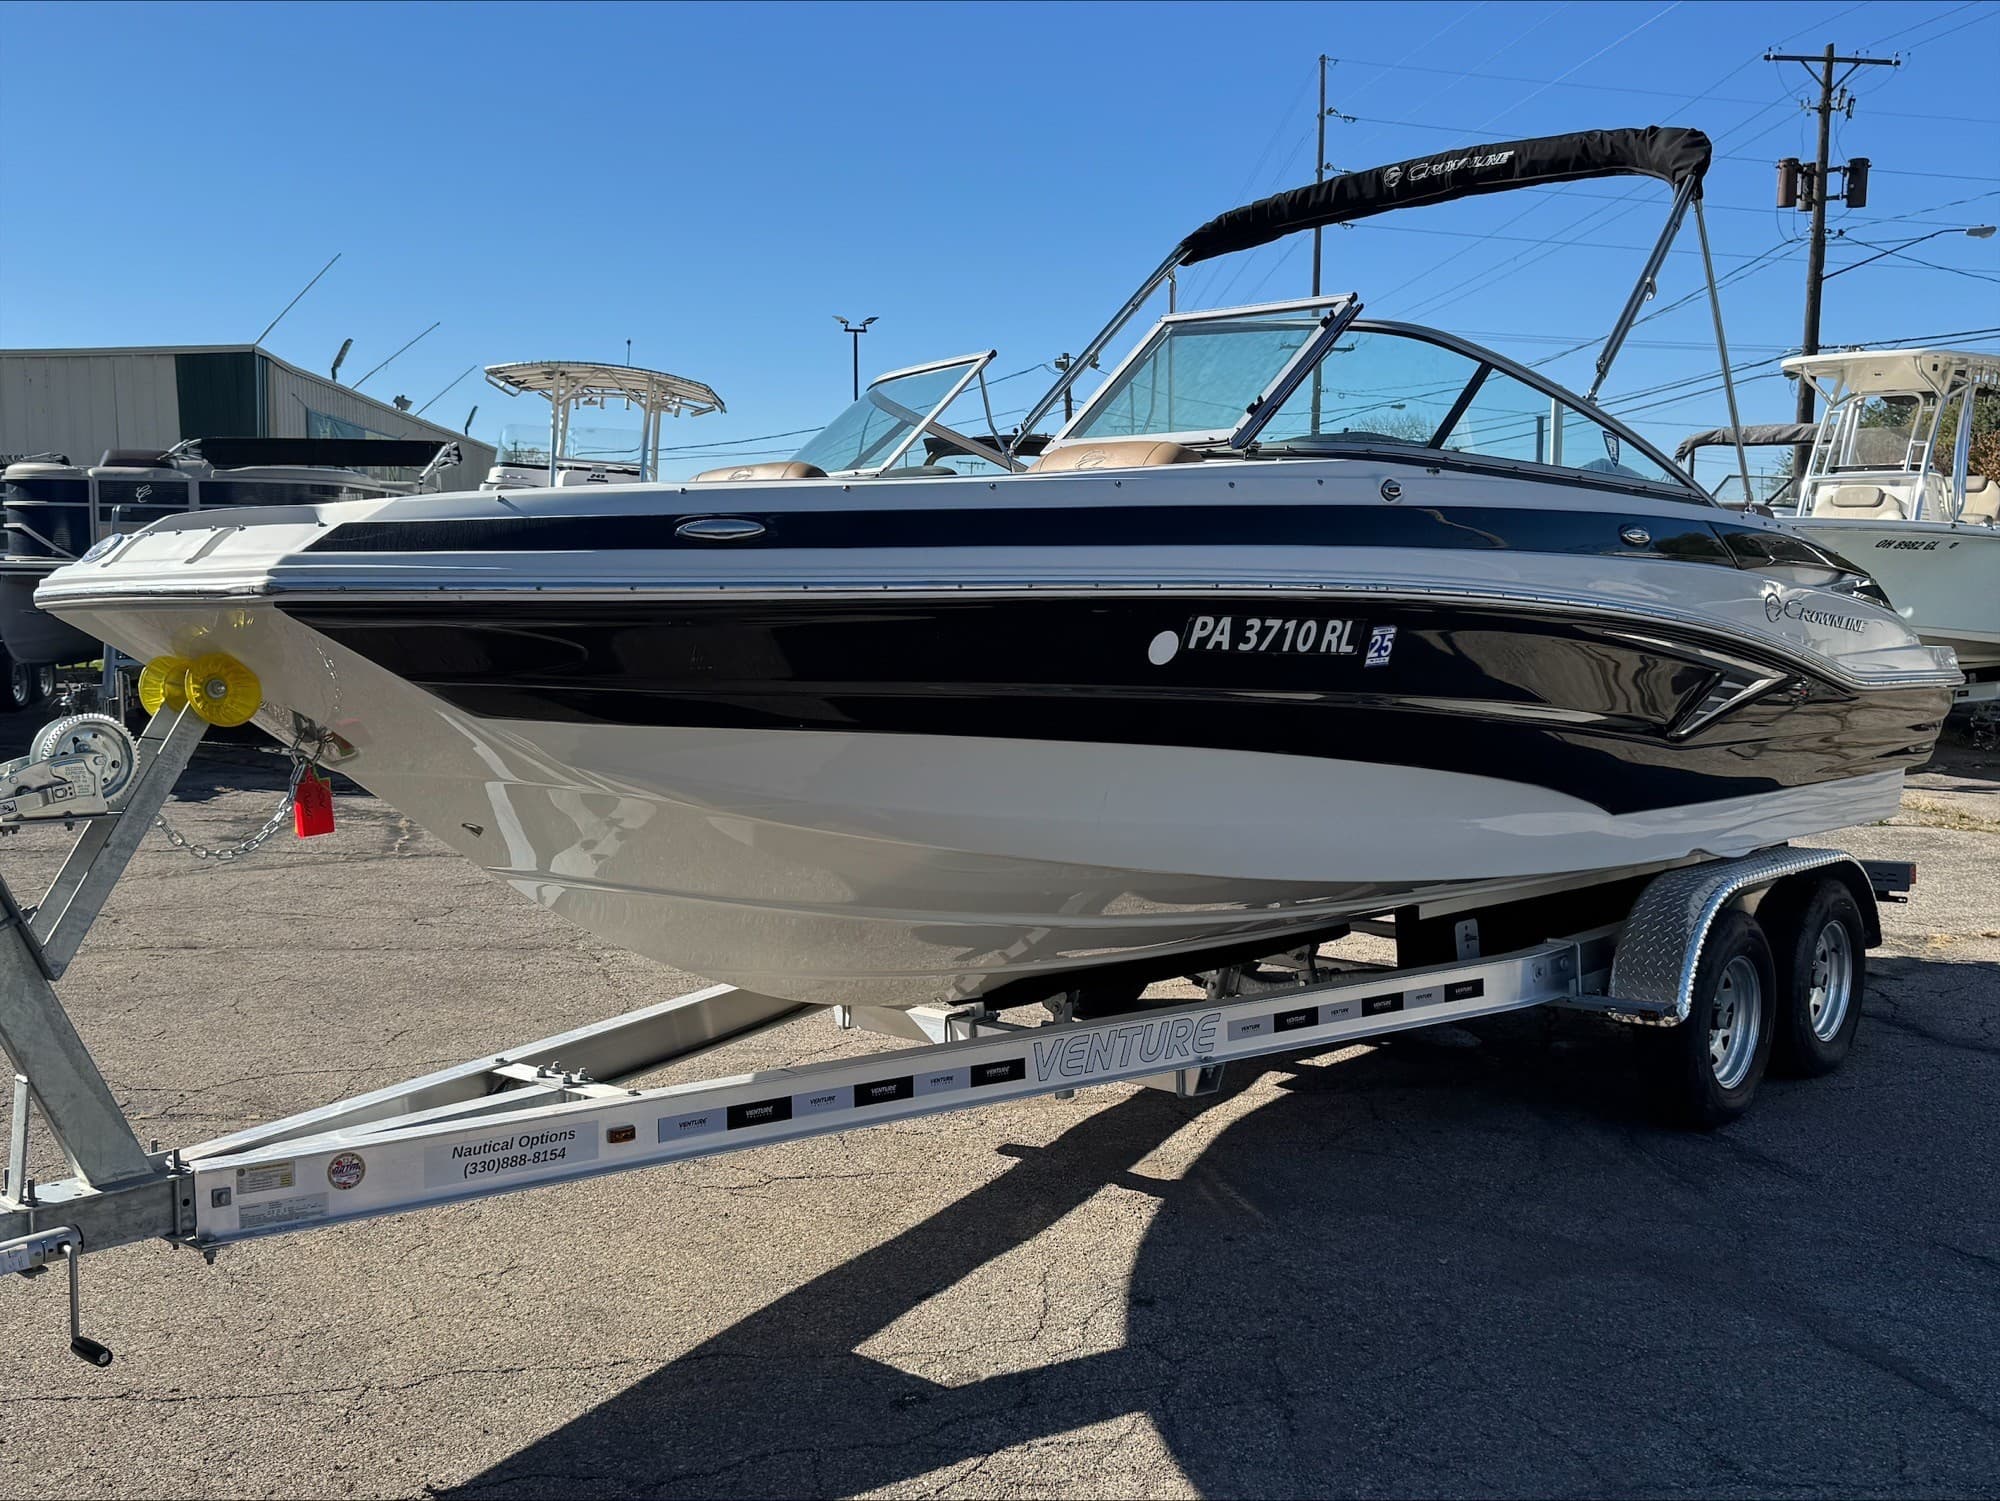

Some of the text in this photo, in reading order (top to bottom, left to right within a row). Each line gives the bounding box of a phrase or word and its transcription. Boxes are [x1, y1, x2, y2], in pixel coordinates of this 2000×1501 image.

[1875, 539, 1897, 549] OH
[1187, 615, 1354, 653] PA 3710 RL
[1369, 633, 1394, 657] 25
[1032, 1012, 1221, 1082] VENTURE
[745, 1106, 773, 1117] VENTURE
[810, 1095, 836, 1105] VENTURE
[678, 1117, 707, 1128] VENTURE
[452, 1128, 576, 1159] Nautical Options
[463, 1147, 566, 1179] (330)888-8154
